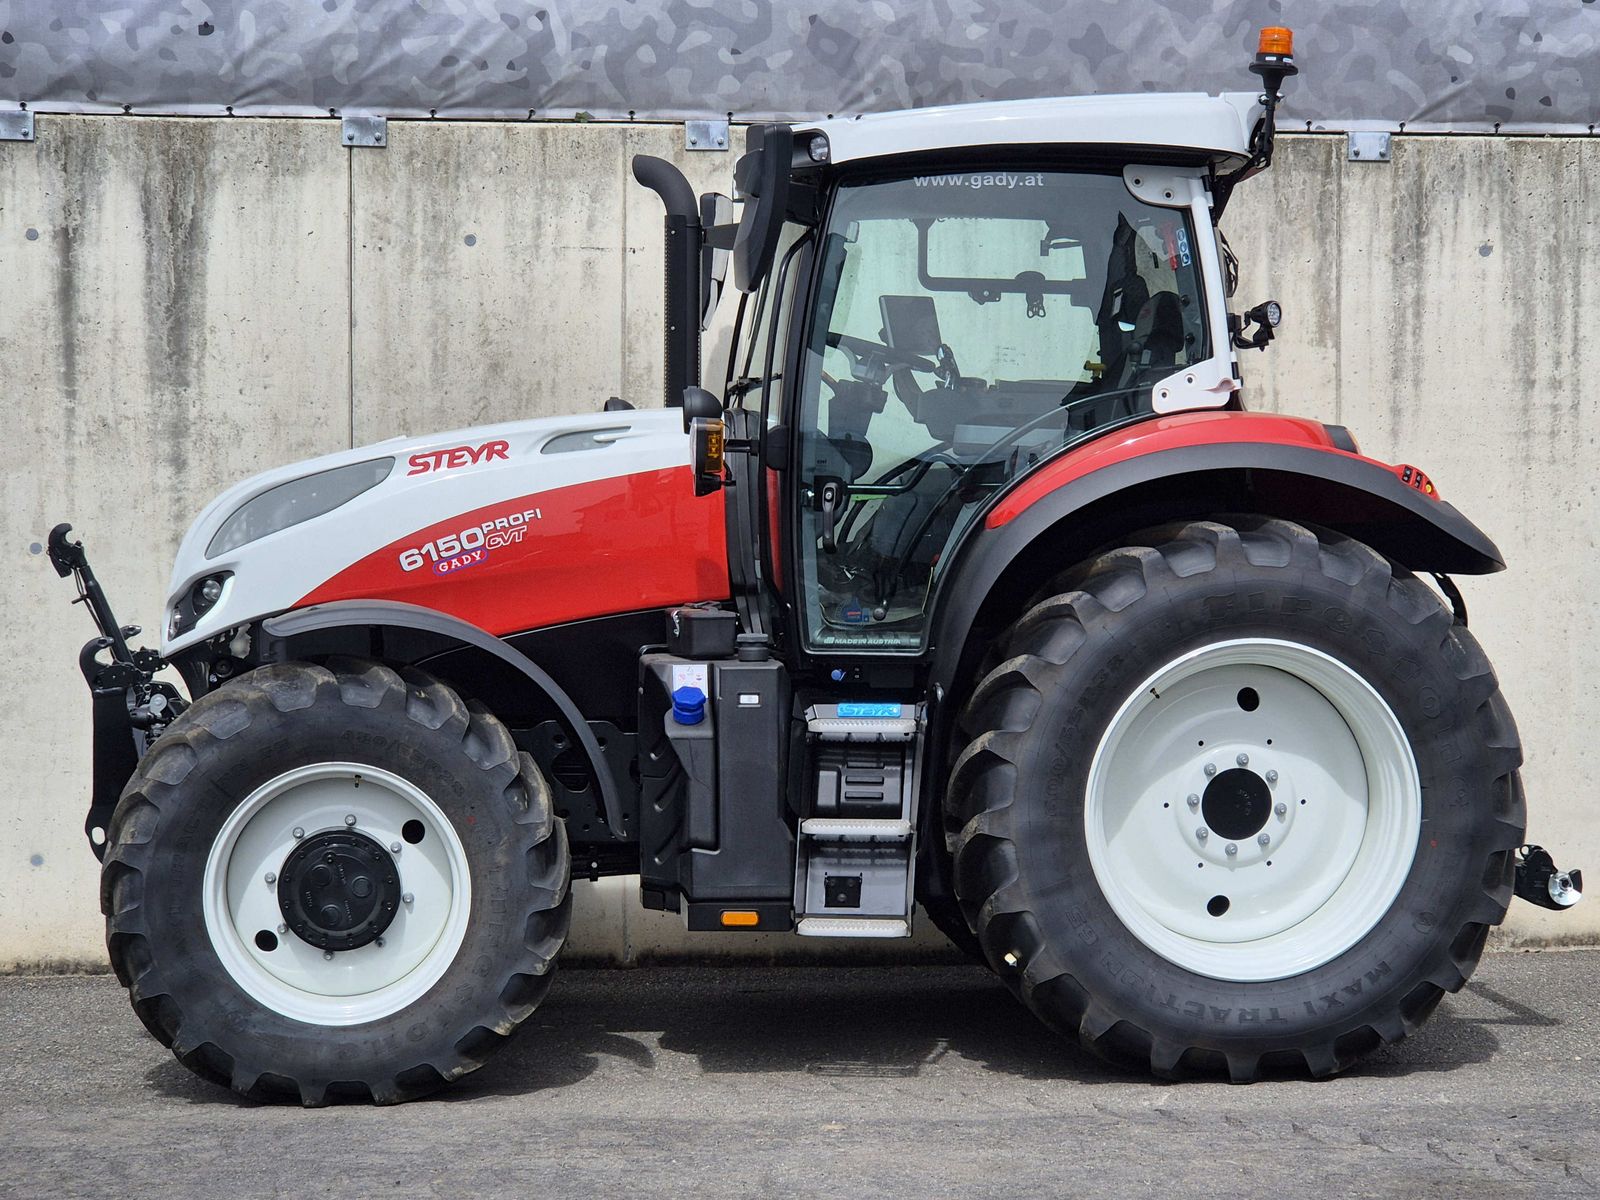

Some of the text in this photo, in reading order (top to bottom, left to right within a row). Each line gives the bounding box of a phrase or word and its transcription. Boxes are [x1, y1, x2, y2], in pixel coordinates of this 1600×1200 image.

[913, 172, 1044, 189] www.gady.at
[407, 440, 510, 476] STEYR
[399, 508, 542, 572] 6150 PROFI
[486, 526, 527, 549] CVT
[438, 550, 484, 573] GADY
[1102, 952, 1288, 1024] TRACTION
[1303, 961, 1393, 1016] MAXI
